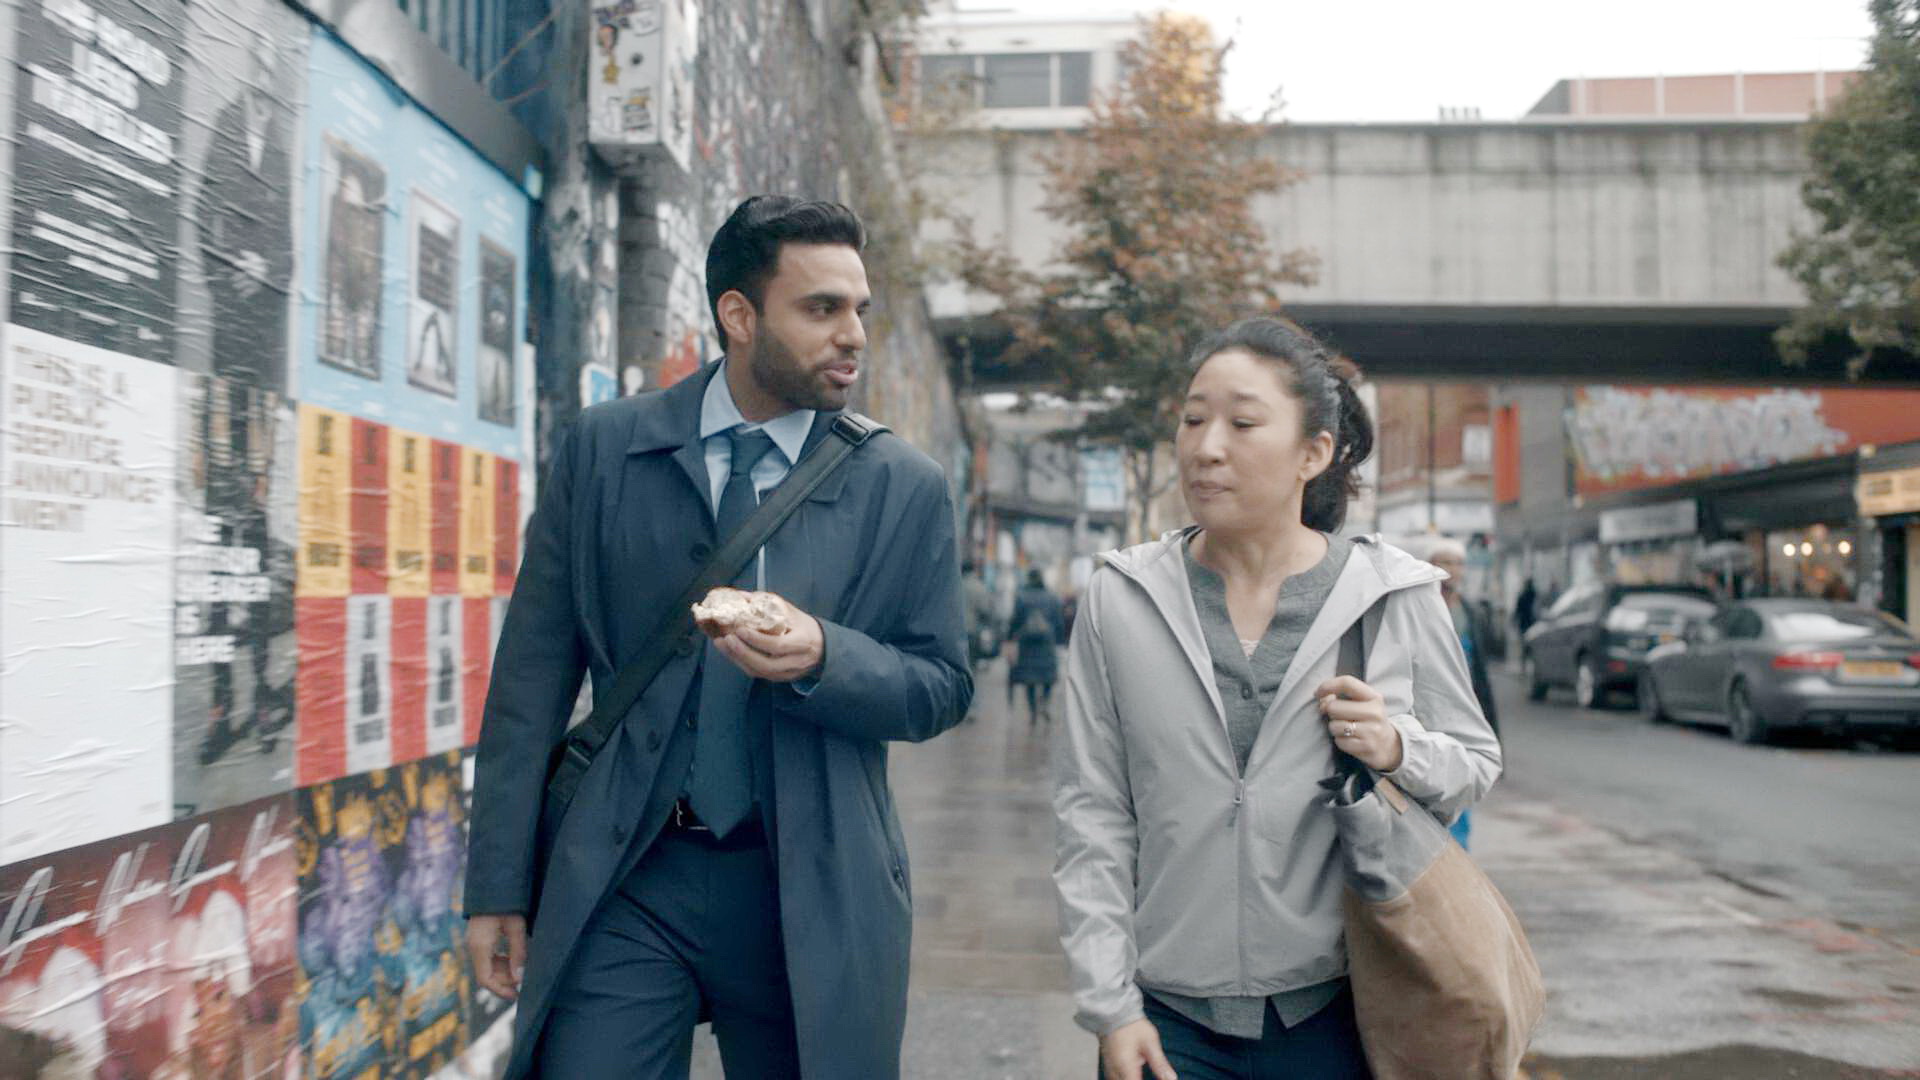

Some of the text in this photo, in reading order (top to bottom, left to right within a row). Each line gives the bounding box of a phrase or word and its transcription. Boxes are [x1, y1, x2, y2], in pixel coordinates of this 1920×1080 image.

[72, 40, 139, 111] LESS
[11, 383, 107, 430] PUBLIC
[10, 419, 123, 467] SERVICE
